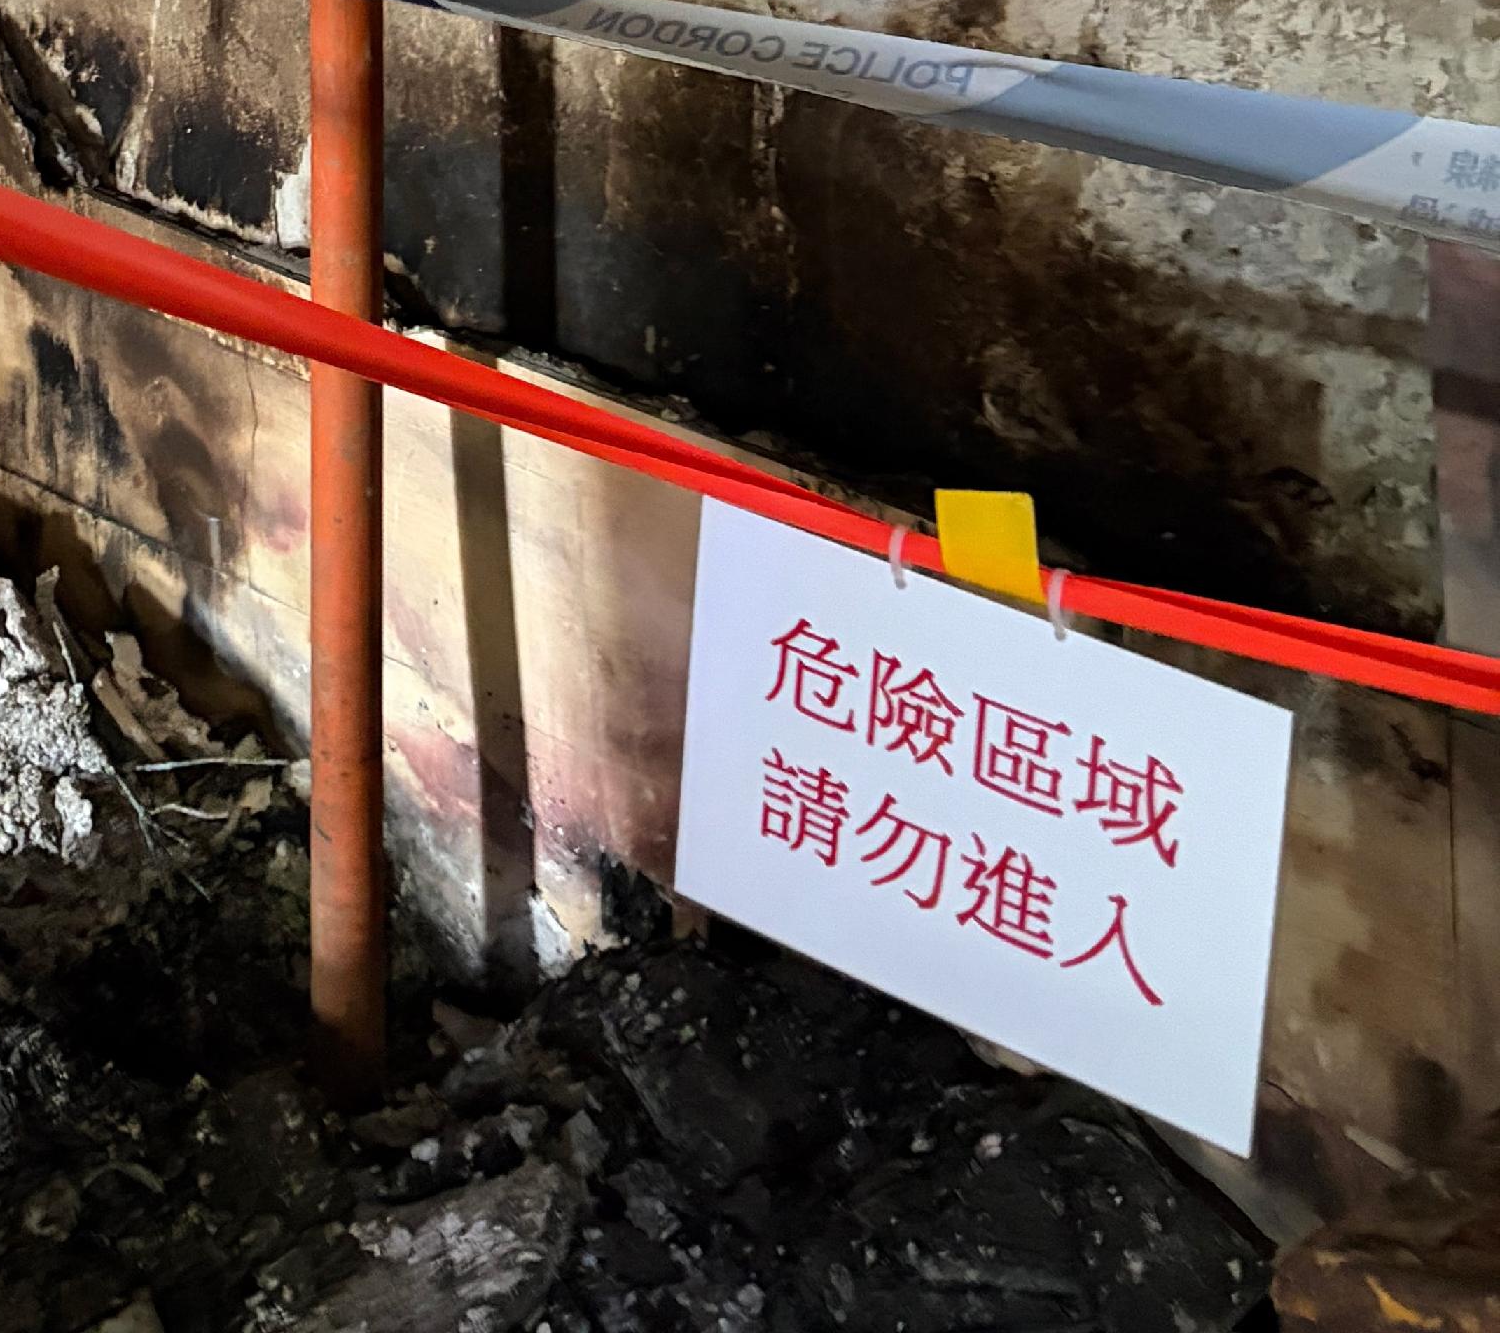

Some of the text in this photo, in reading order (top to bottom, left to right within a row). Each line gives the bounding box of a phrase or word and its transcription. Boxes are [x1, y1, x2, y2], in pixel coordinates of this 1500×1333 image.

[764, 617, 1185, 869] 危險區域
[758, 746, 1164, 1007] 請勿進入
